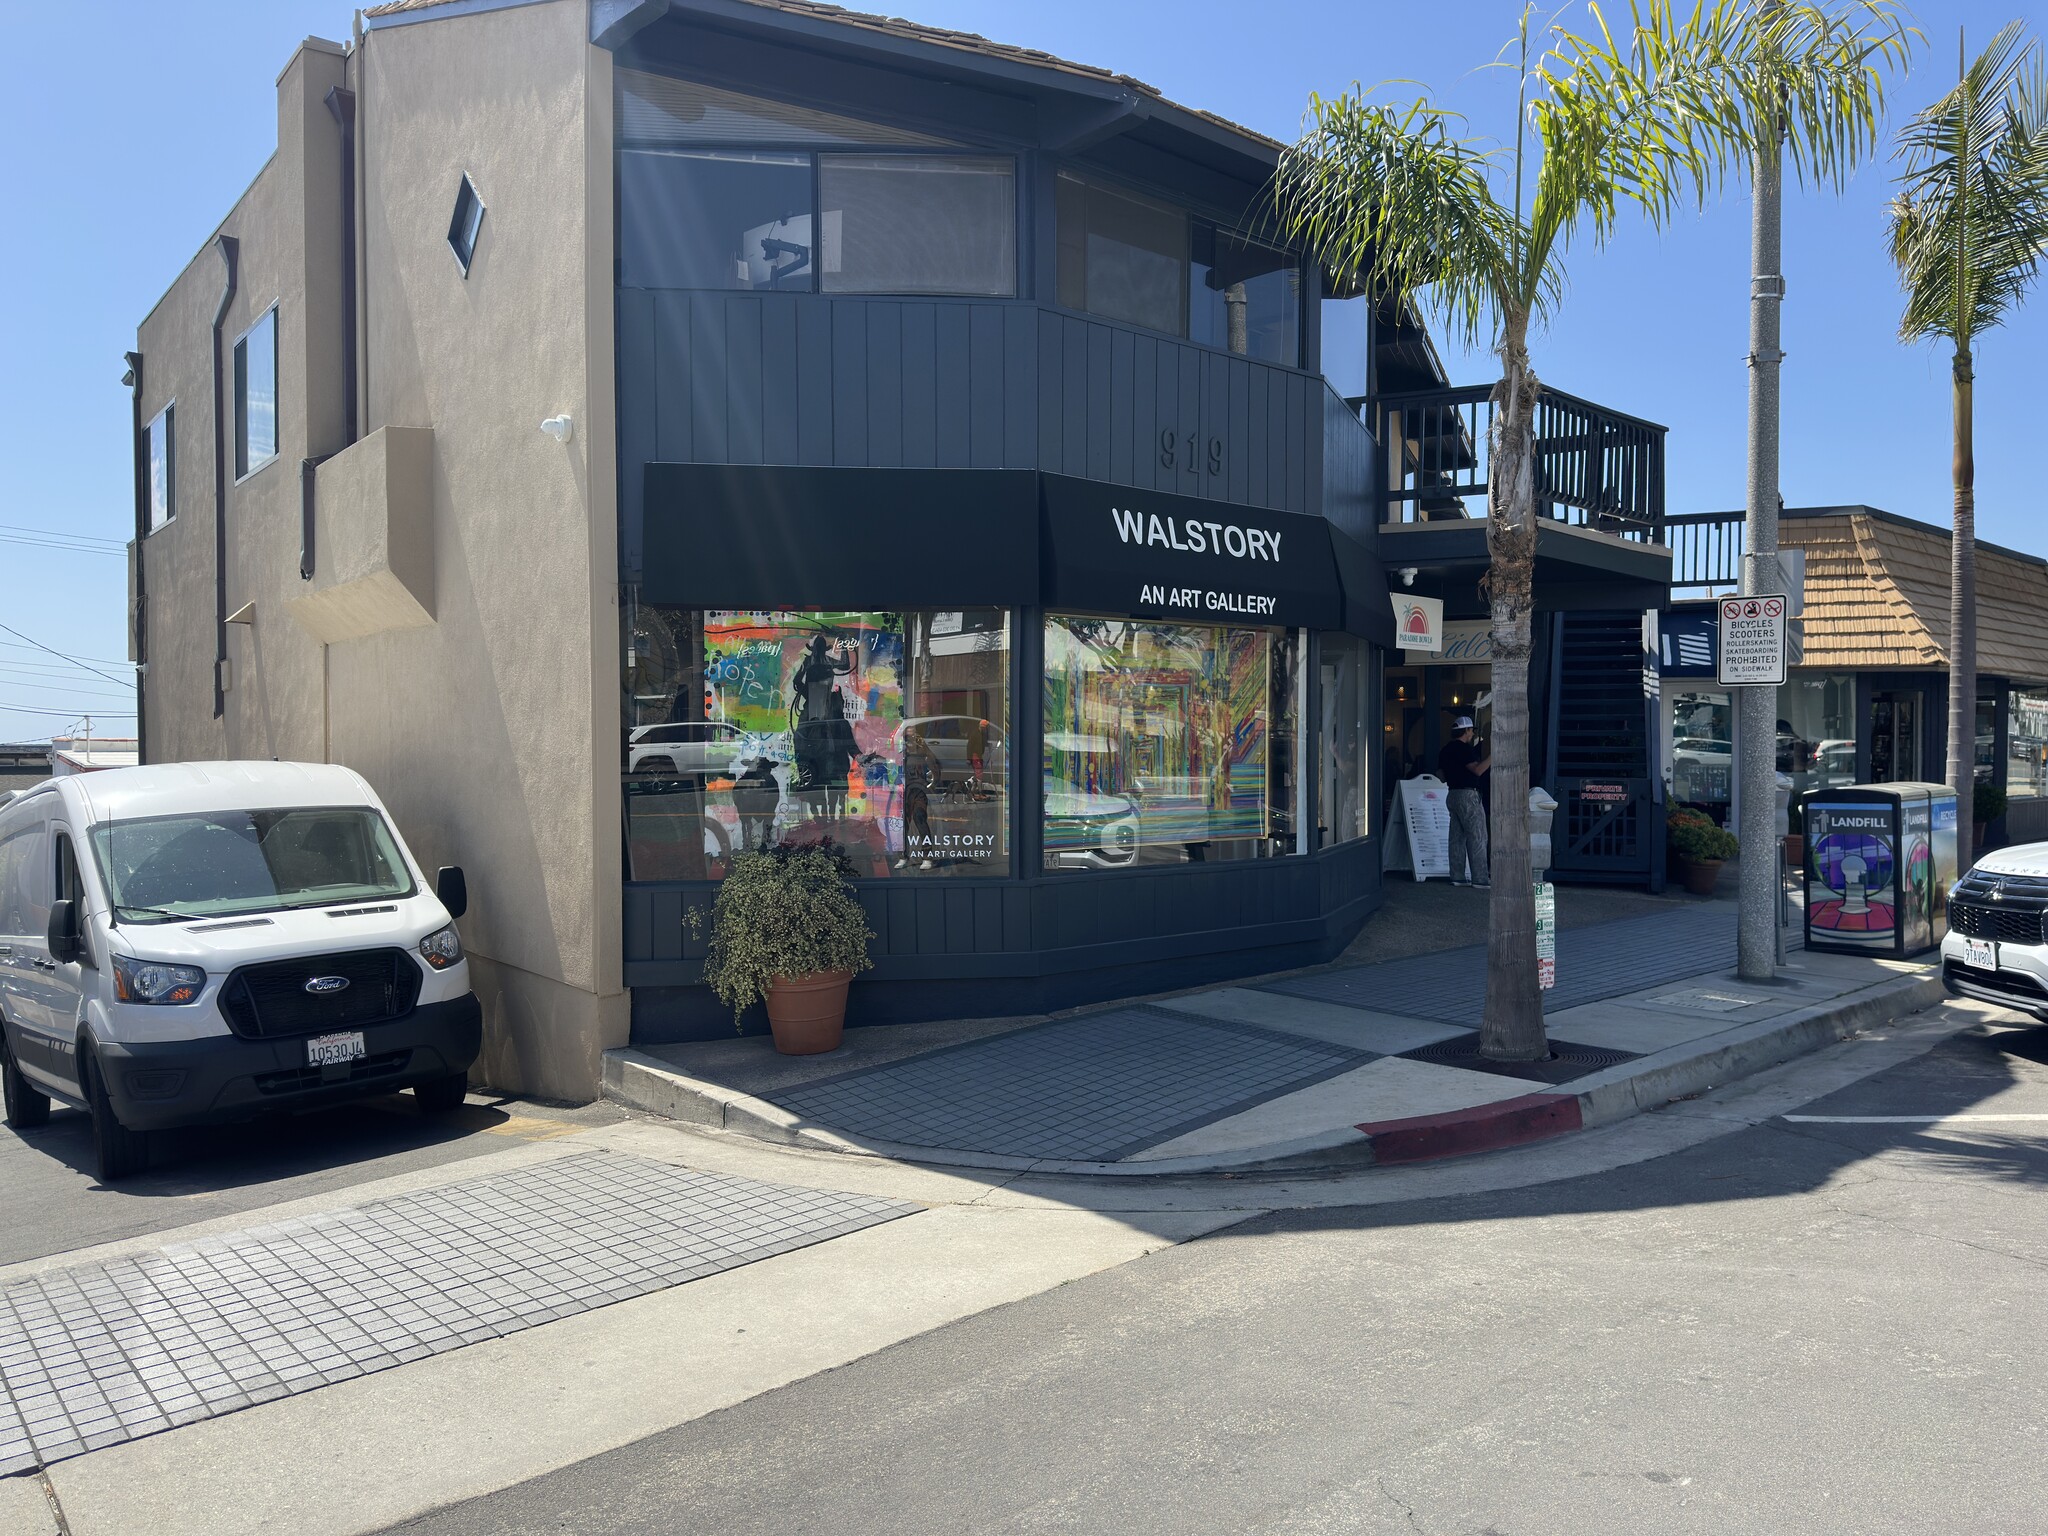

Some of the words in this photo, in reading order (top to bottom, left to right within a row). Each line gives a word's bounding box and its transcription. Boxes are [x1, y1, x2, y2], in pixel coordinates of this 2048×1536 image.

[1161, 427, 1222, 477] 919
[1111, 507, 1282, 563] WALSTORY
[1140, 584, 1165, 605] AN
[1169, 587, 1202, 608] ART
[1205, 591, 1276, 615] GALLERY
[1731, 620, 1774, 629] BICYCLES
[1730, 630, 1774, 638] SCOOTERS
[1725, 647, 1778, 655] SKATEBOARDING
[1726, 656, 1777, 664] PROHIBITED
[1831, 817, 1888, 828] LANDFILL
[1909, 813, 1928, 826] LANDFILL
[907, 835, 994, 846] WALSTORY
[316, 979, 341, 990] Ford
[311, 1041, 362, 1060] 10530J4
[322, 1054, 355, 1066] FAIRWAY
